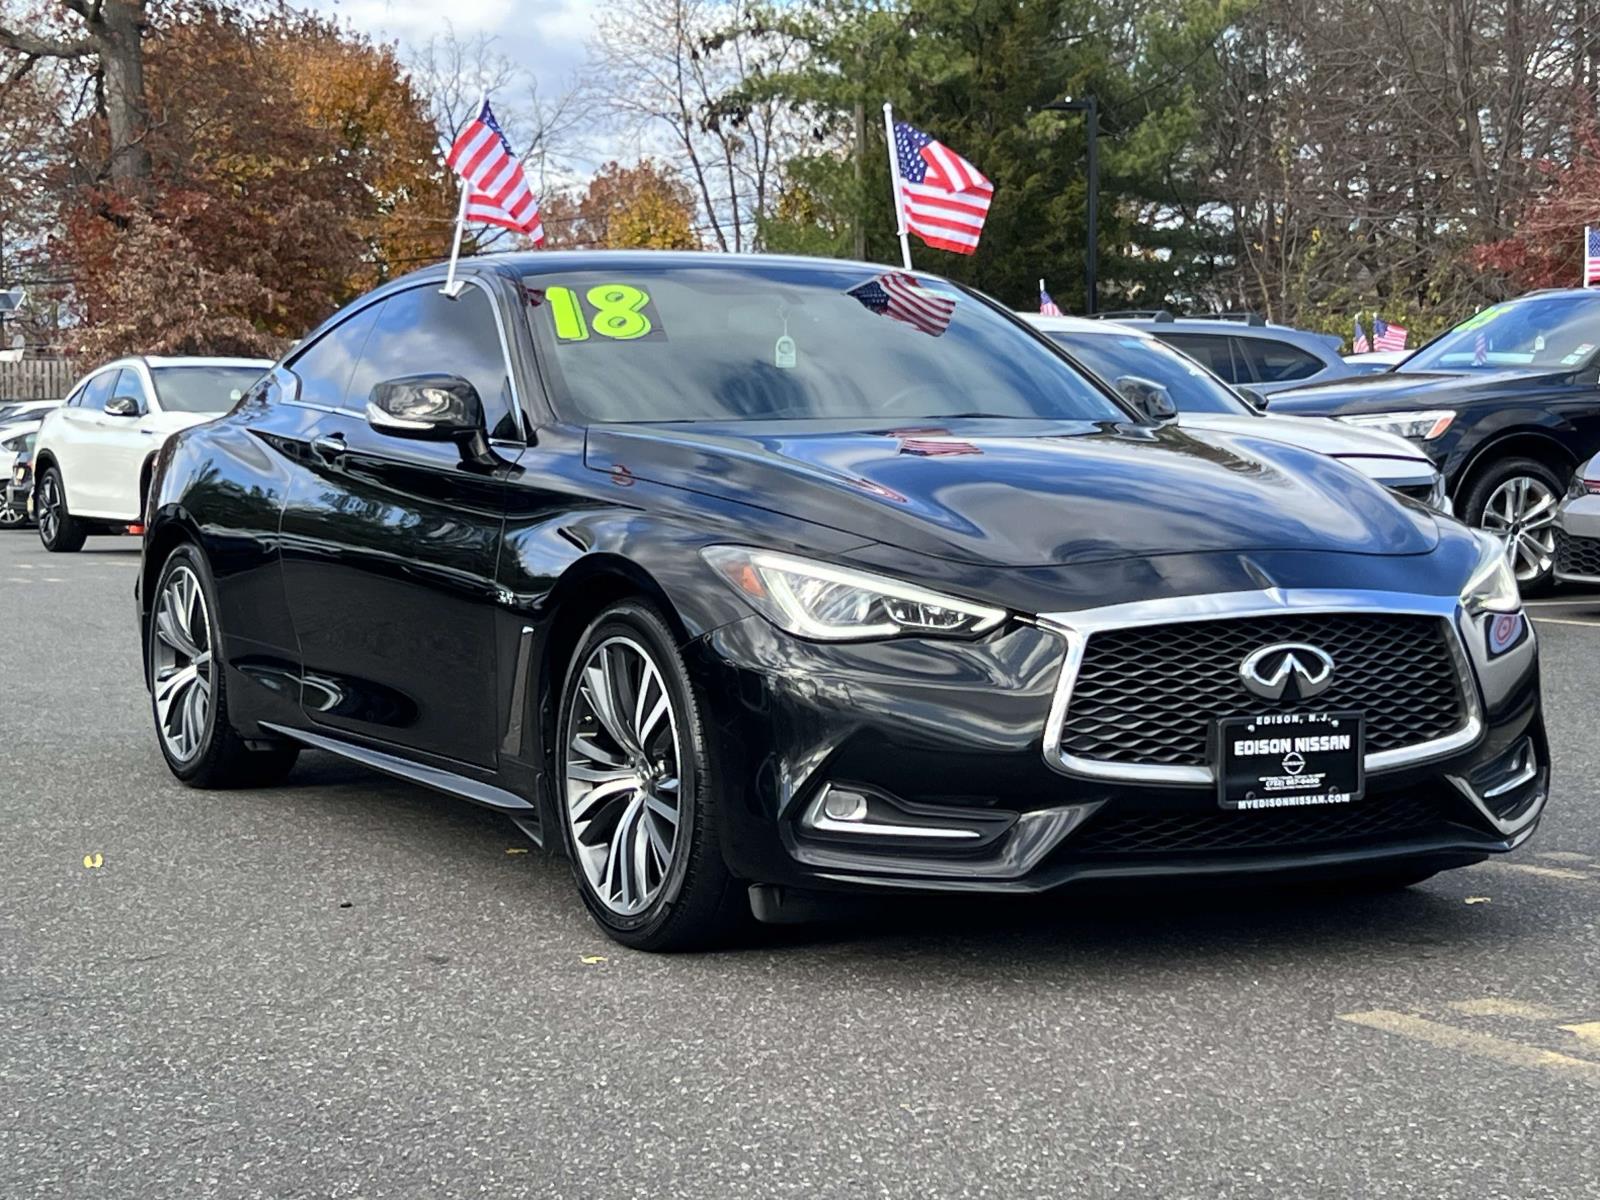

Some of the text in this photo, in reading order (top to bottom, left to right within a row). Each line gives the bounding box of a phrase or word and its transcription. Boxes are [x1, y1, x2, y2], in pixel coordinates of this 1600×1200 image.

[545, 284, 652, 341] 18
[1256, 713, 1331, 725] EDISON, N.J.
[1234, 735, 1350, 756] EDISON NISSAN
[1237, 794, 1350, 809] MYEDISONNISSAN.COM
